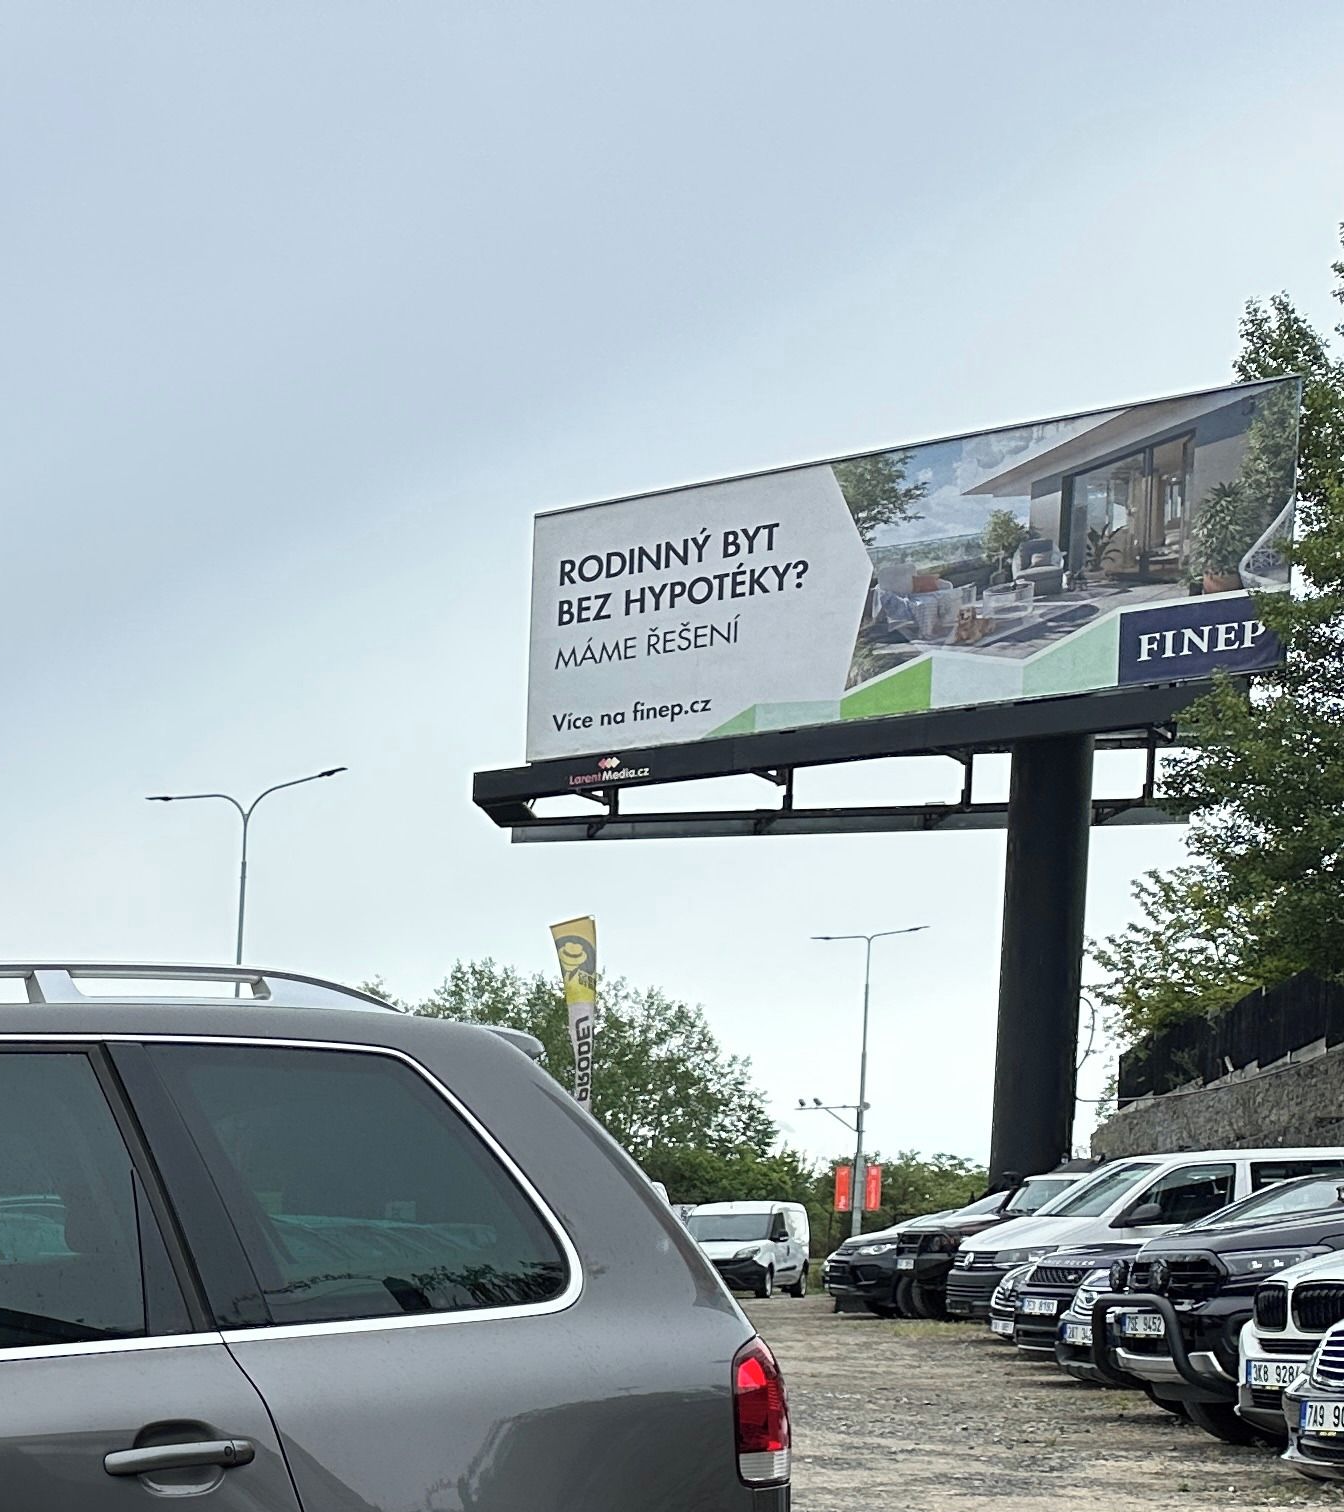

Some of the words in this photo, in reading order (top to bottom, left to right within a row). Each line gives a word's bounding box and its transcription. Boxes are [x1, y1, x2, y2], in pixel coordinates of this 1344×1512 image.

[559, 527, 712, 586] RODINNÝ
[722, 522, 780, 558] BYT
[557, 592, 613, 627] BEZ
[624, 559, 810, 616] HYPOTÉKY?
[554, 637, 638, 670] MÁME
[646, 613, 741, 656] ŘEŠENÍ
[1137, 619, 1267, 662] FINEP
[552, 712, 594, 732] Více
[600, 711, 625, 726] na
[632, 698, 712, 723] finep.cz
[569, 766, 650, 786] LarentMedia.cz
[1143, 1315, 1162, 1332] 9452
[1307, 1404, 1325, 1427] 7A9
